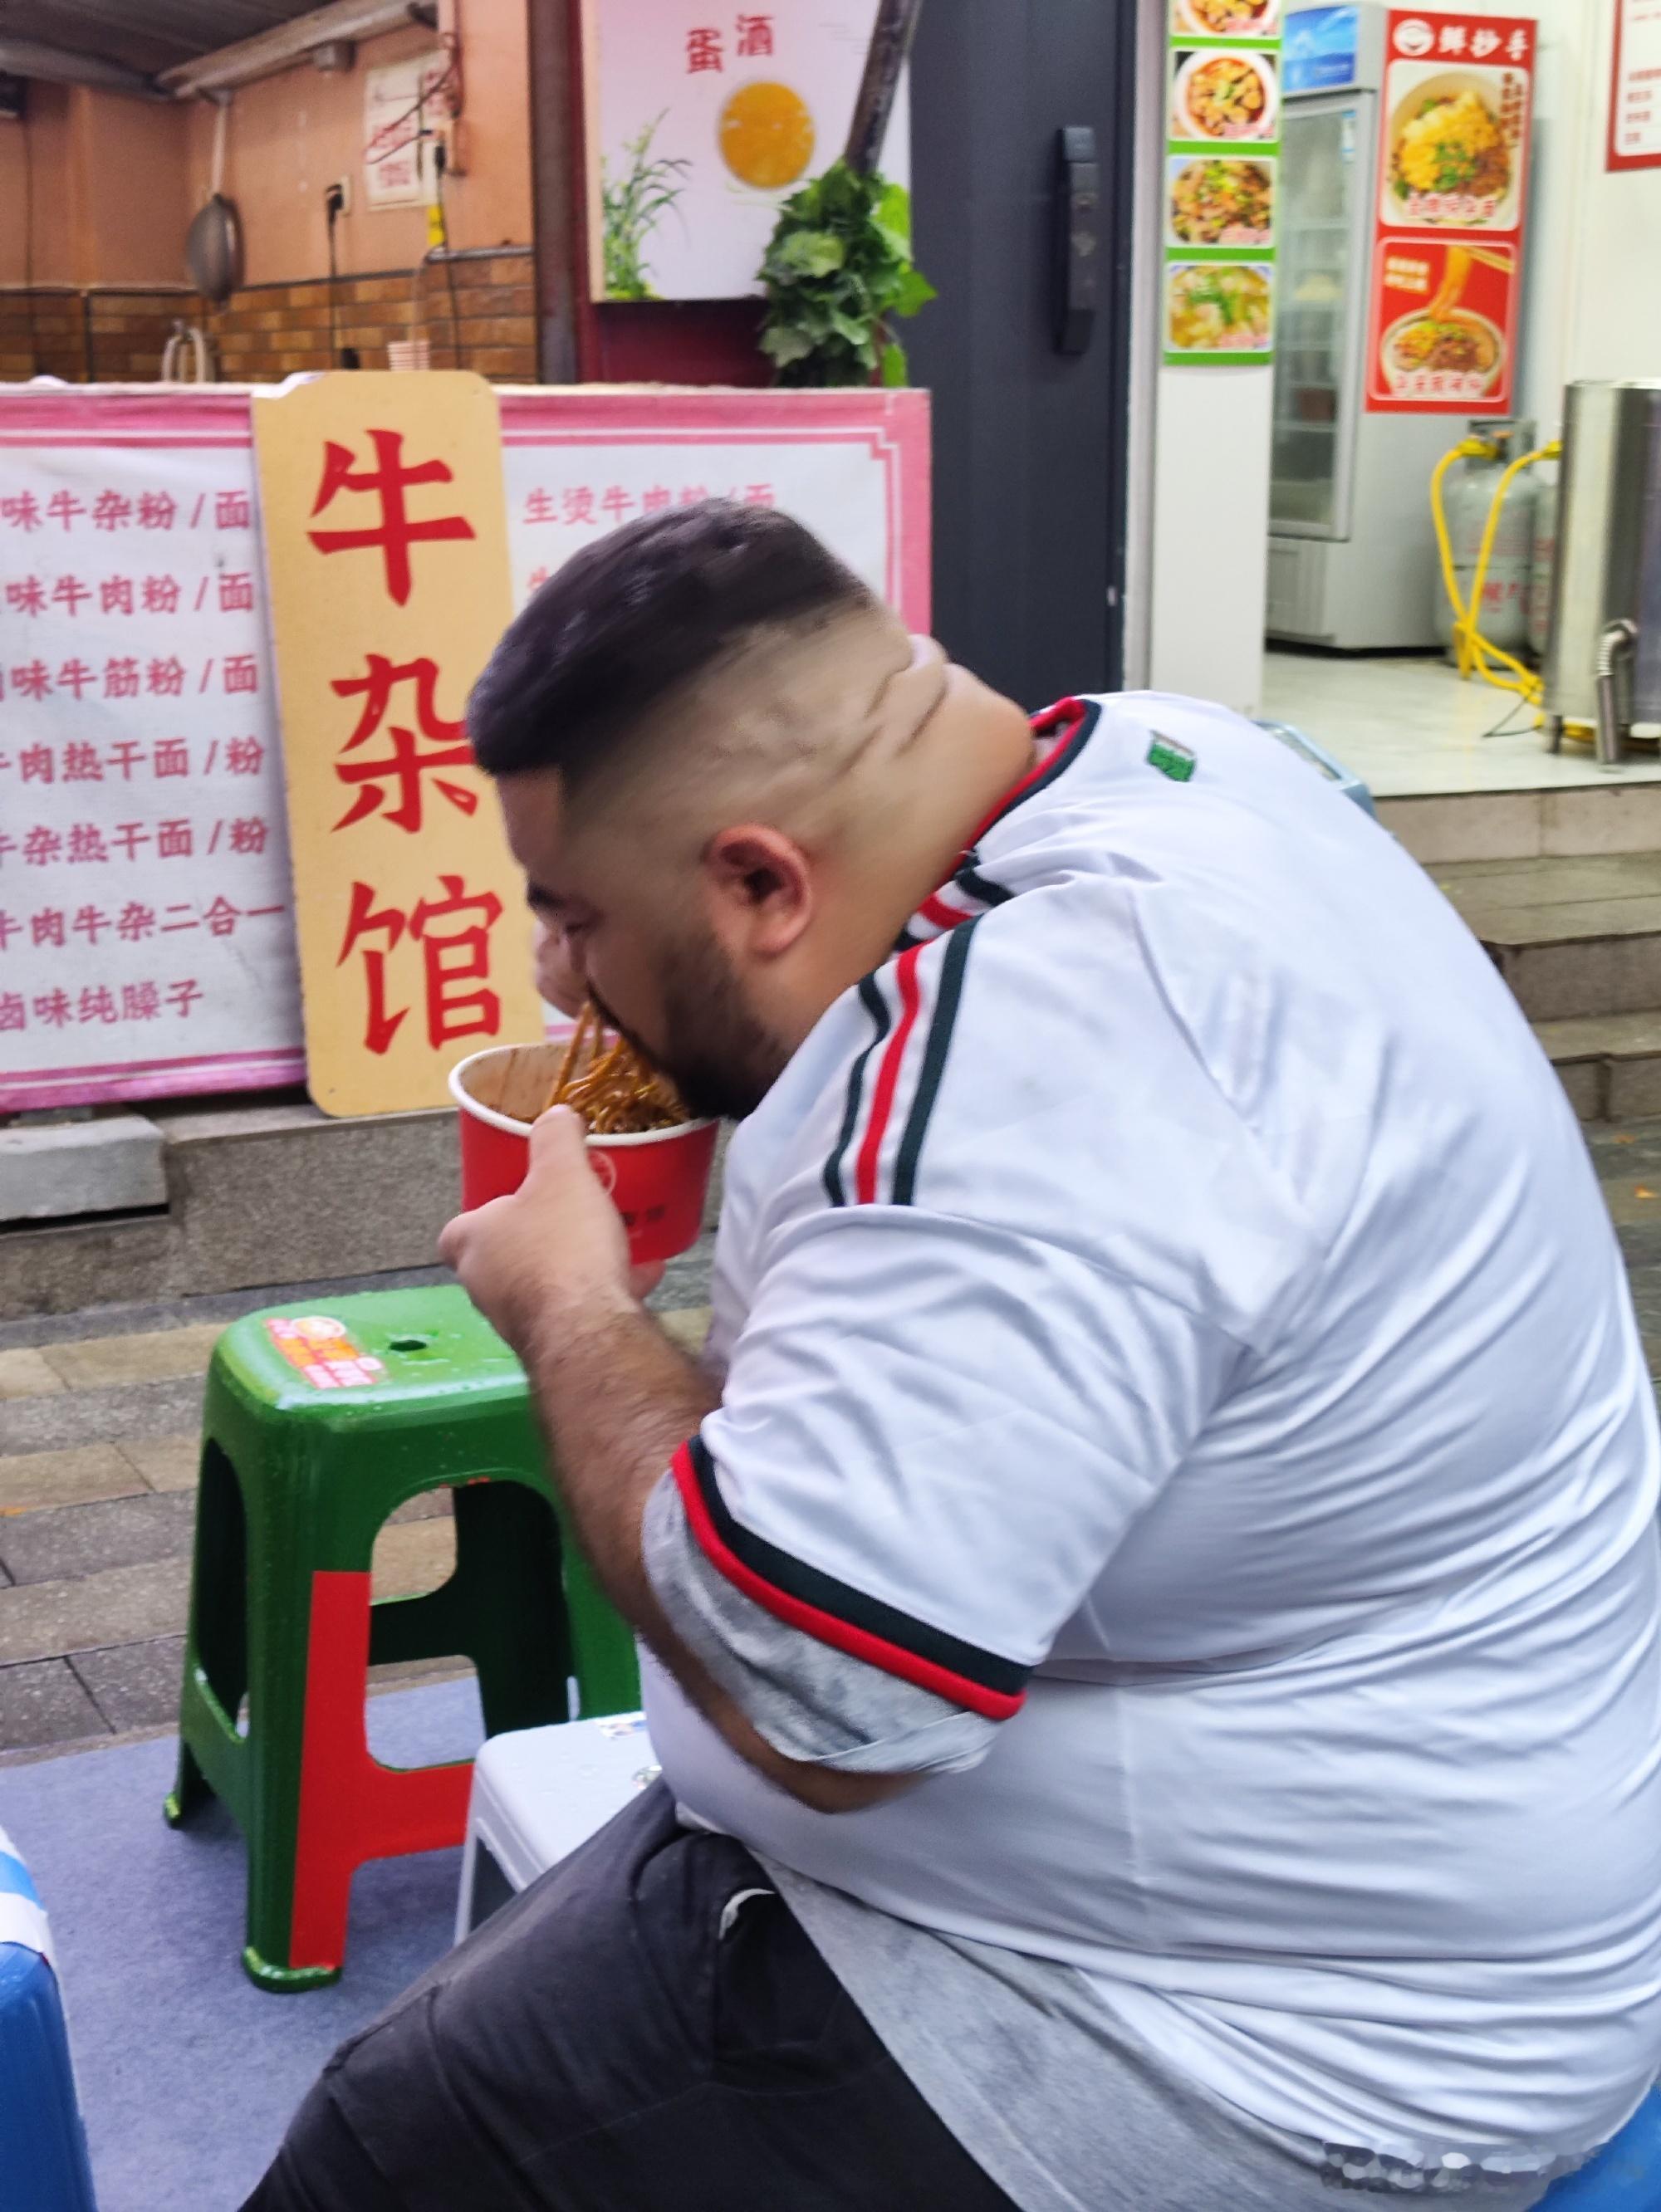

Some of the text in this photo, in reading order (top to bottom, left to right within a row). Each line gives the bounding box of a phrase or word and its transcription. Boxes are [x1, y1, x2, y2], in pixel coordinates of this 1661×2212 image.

[685, 14, 776, 74] 蛋酒
[0, 654, 258, 702] 味牛筋粉/面
[306, 428, 504, 1056] 牛杂馆
